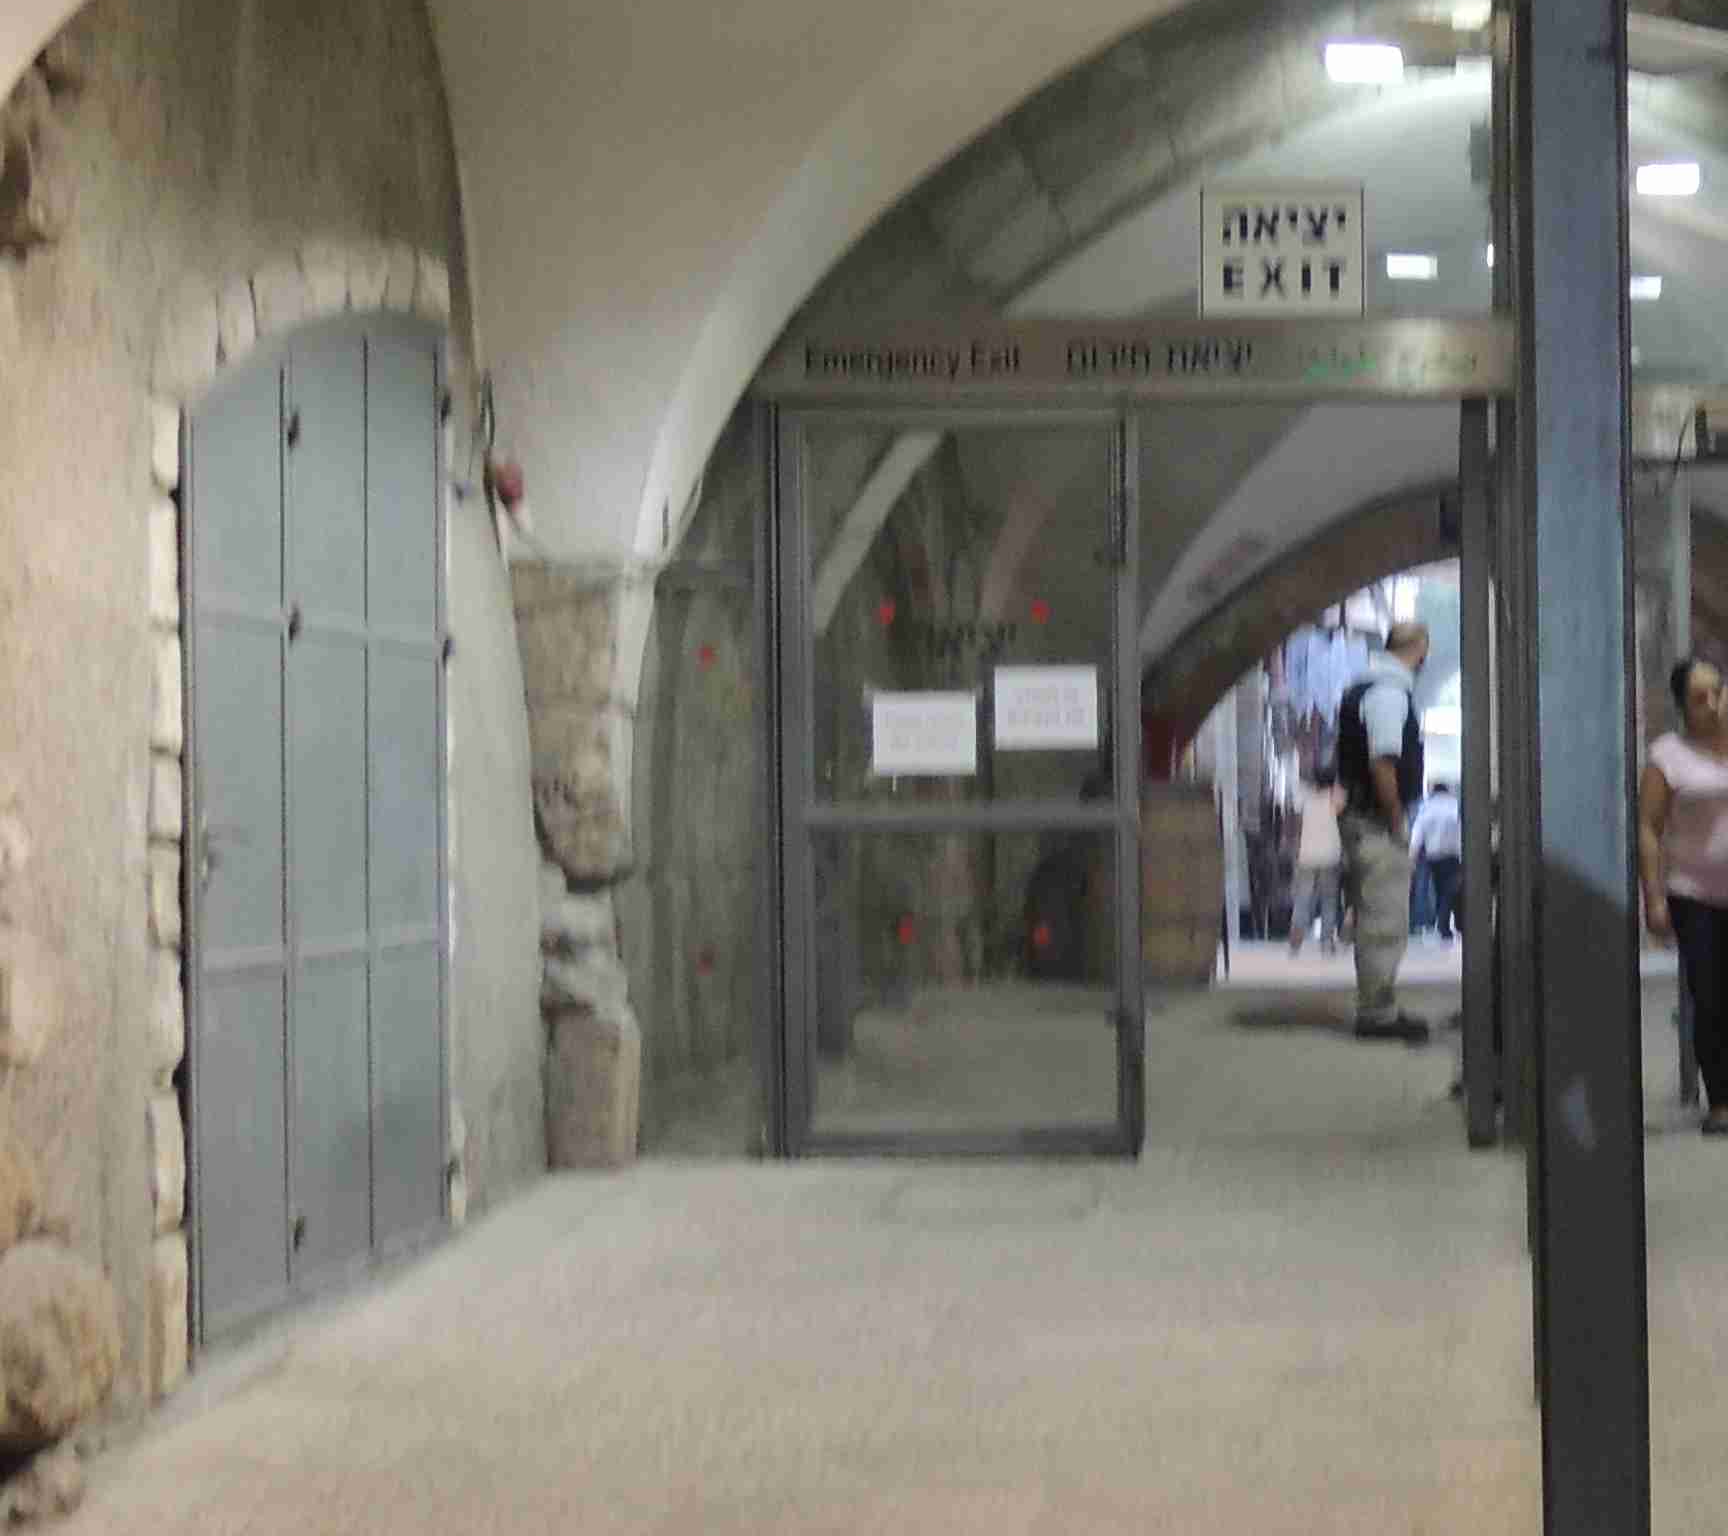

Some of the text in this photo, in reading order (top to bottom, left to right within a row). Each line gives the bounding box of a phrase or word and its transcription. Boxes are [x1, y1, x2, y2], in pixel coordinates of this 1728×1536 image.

[1221, 204, 1346, 244] יציאה
[1221, 261, 1346, 297] EXIT
[804, 339, 960, 382] Emergency
